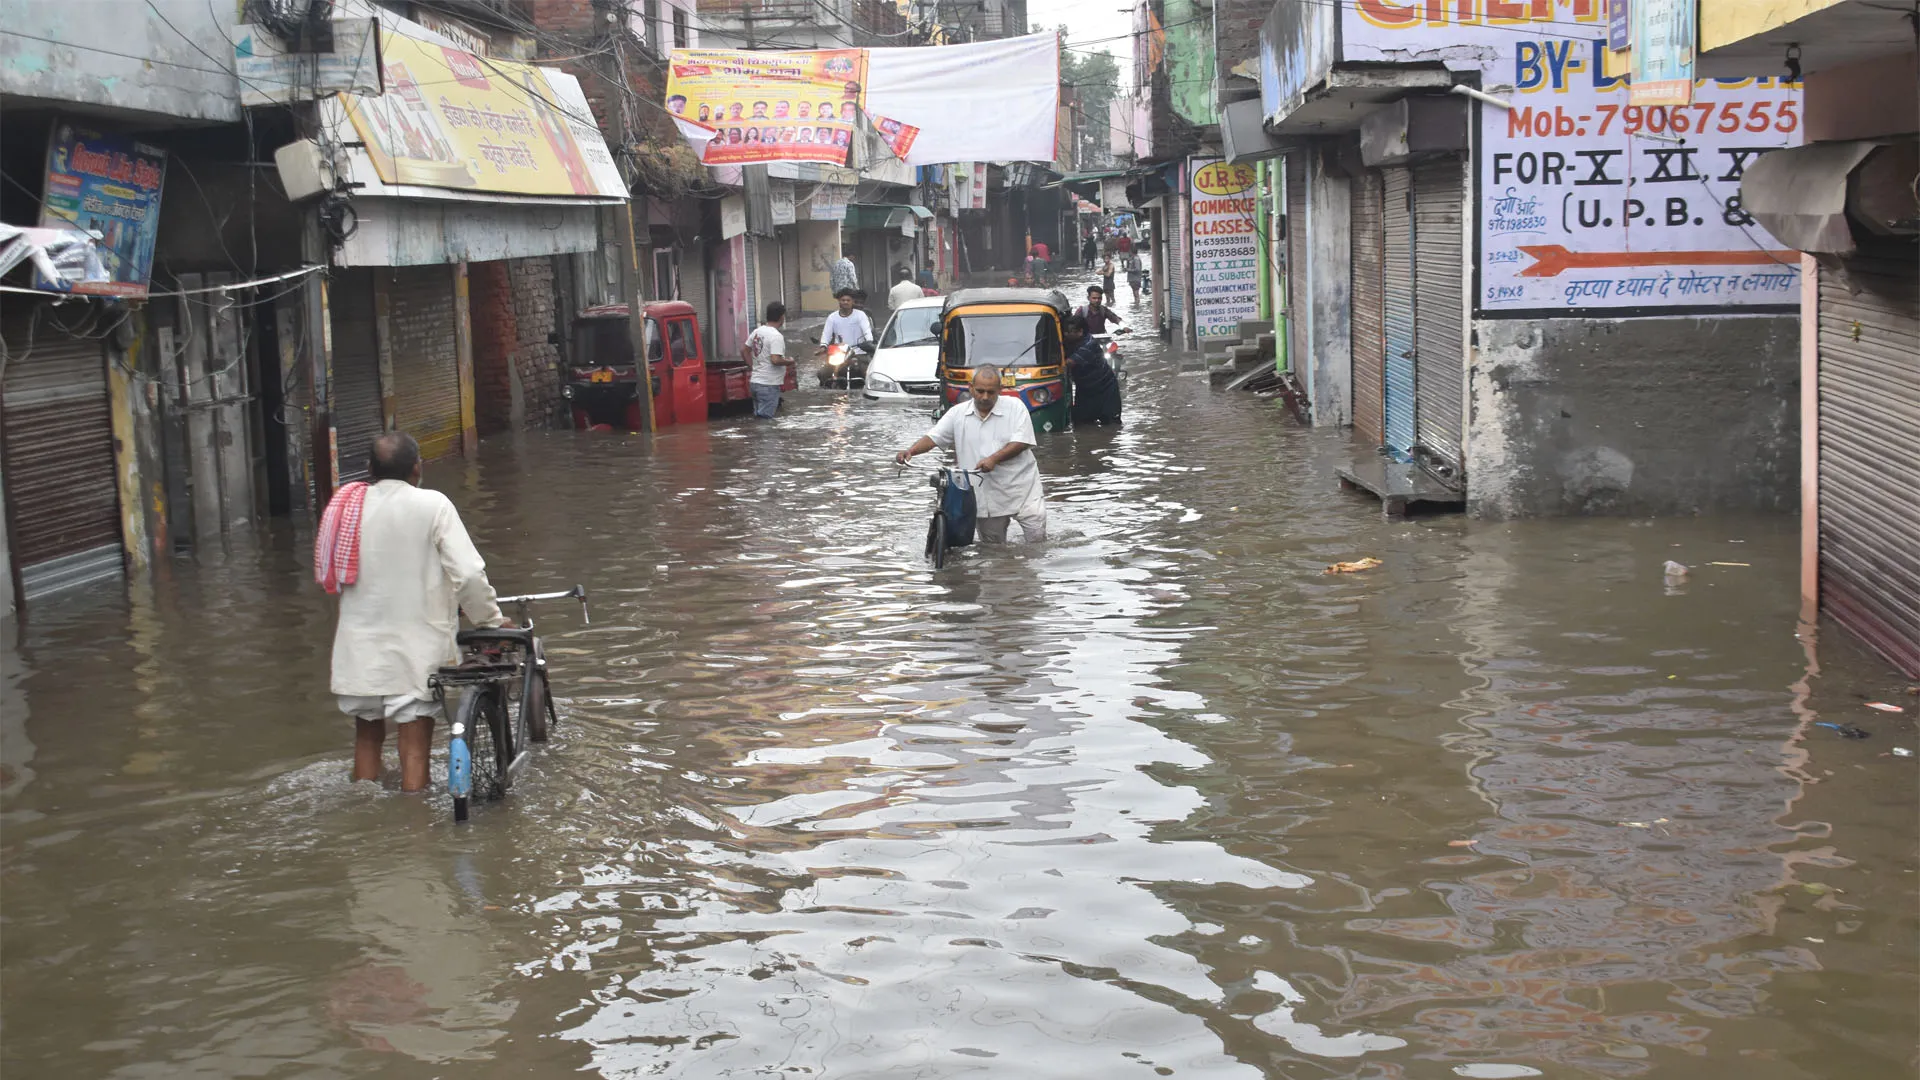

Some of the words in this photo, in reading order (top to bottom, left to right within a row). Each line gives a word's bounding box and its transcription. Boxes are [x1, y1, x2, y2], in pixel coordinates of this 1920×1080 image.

[1193, 198, 1256, 215] COMMERCE
[1194, 218, 1254, 235] CLASSES
[1195, 246, 1256, 259] 9897838689
[1615, 278, 1657, 297] ध्यान
[1677, 269, 1725, 295] पोस्टर
[1727, 275, 1741, 290] न
[1196, 308, 1226, 316] BUSINESS
[1227, 306, 1255, 314] STUDIES
